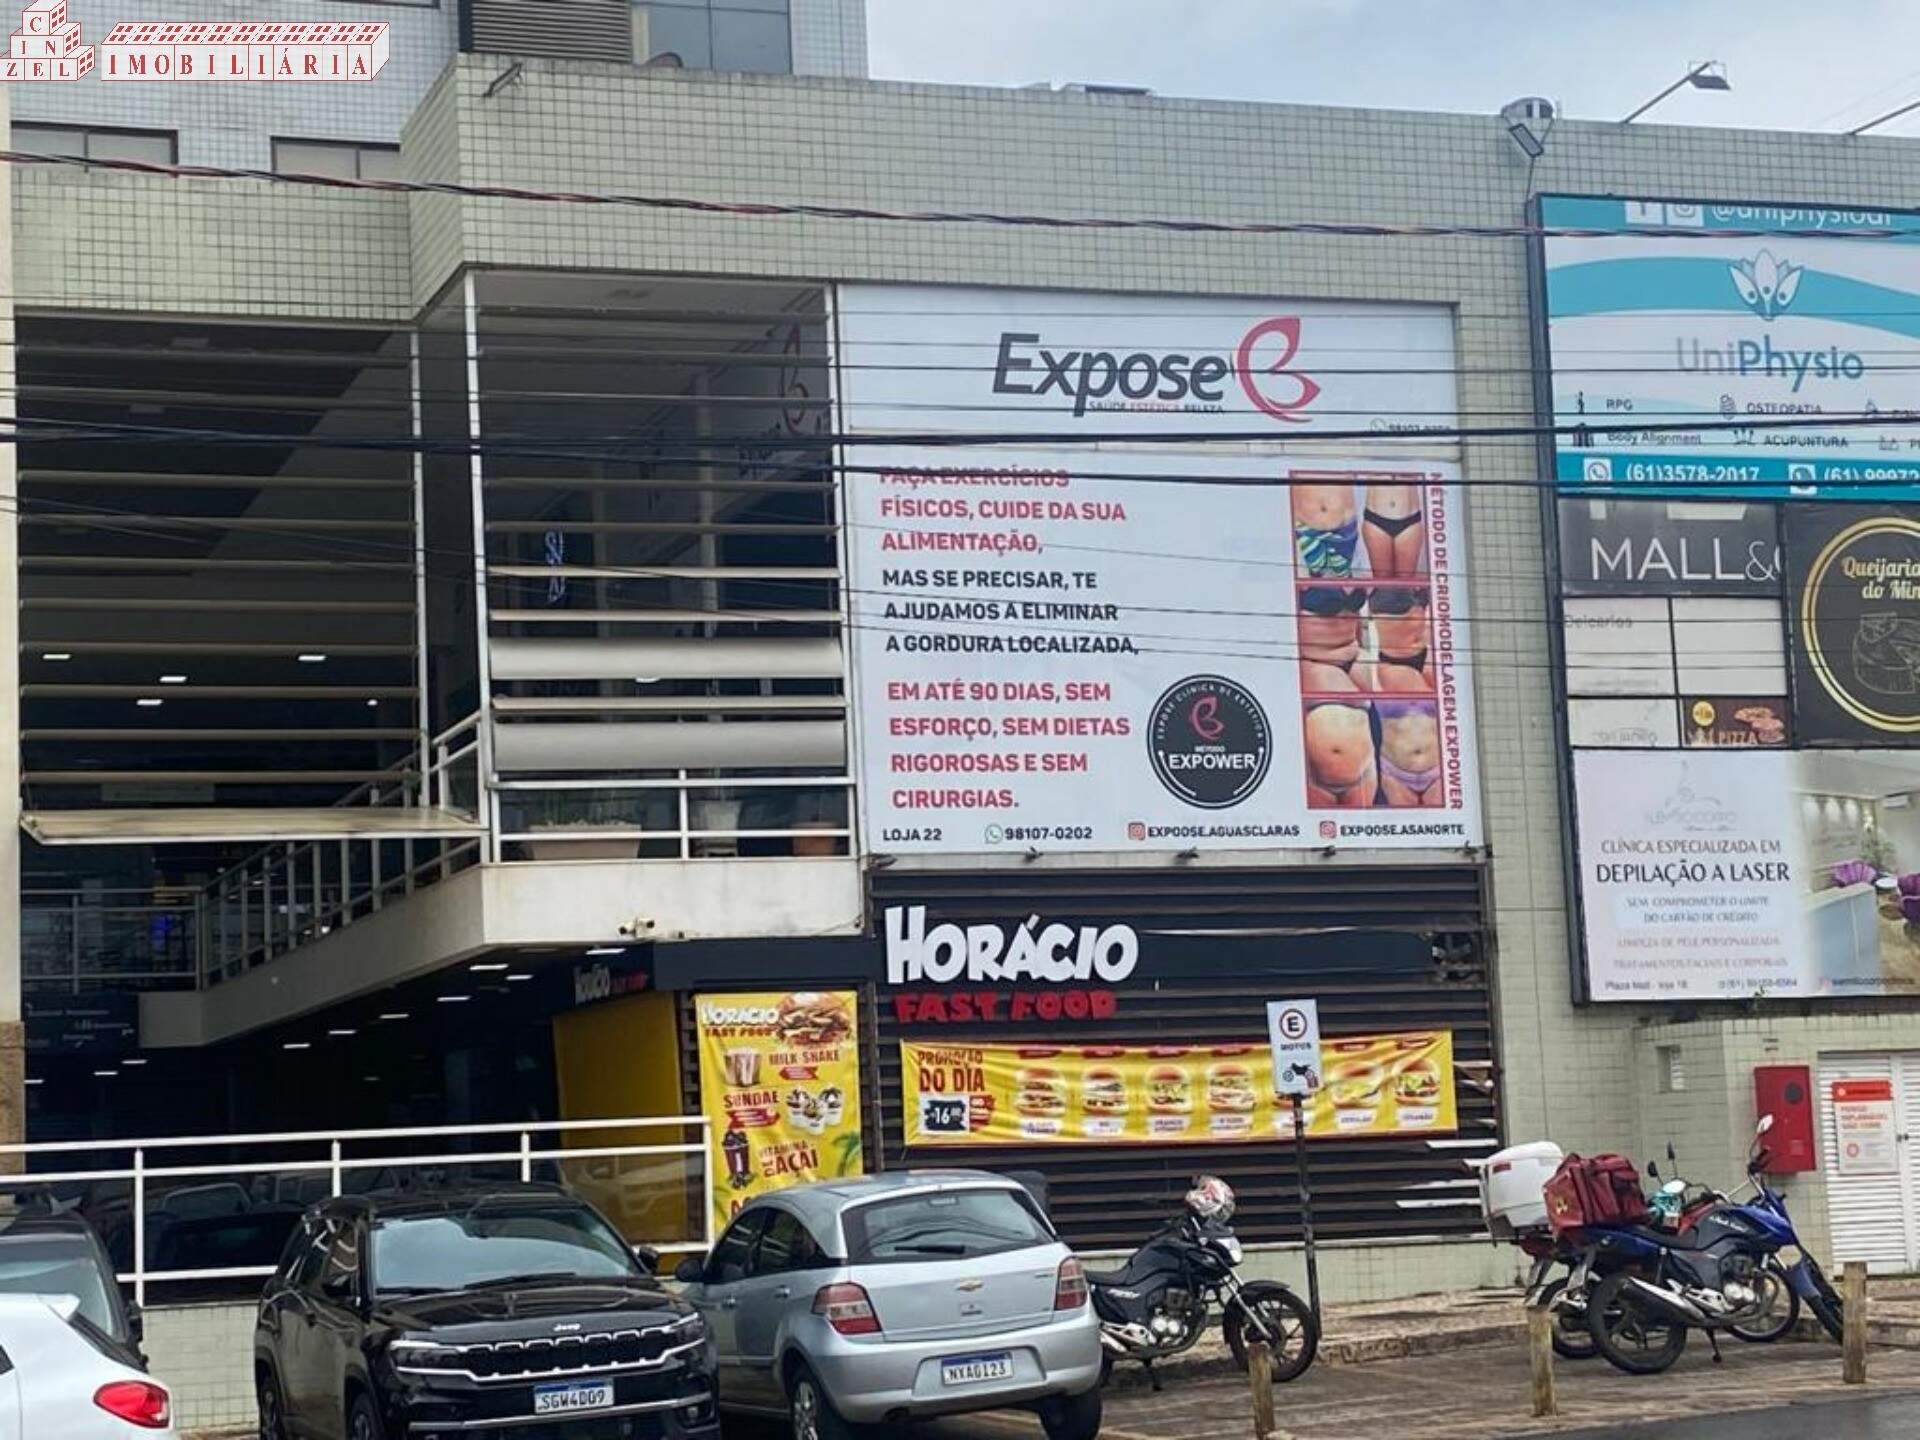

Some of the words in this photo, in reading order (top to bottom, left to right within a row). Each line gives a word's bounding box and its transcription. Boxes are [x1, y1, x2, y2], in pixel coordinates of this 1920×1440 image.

[1675, 335, 1864, 392] UniPhysio
[992, 332, 1229, 418] Expose
[1606, 398, 1633, 411] RPG
[1764, 434, 1850, 448] ACUPUNTURA
[881, 495, 974, 520] FÍSICOS,
[978, 502, 1044, 520] CUIDE
[1048, 502, 1077, 520] DA
[1081, 503, 1126, 521] SUA
[882, 530, 1044, 557] ALIMENTAÇÃO,
[1433, 549, 1449, 571] DE
[882, 570, 928, 587] MAS
[932, 570, 958, 587] SE
[963, 571, 1069, 590] PRECISAR,
[1072, 573, 1097, 589] TE
[1862, 580, 1885, 599] do
[884, 602, 1000, 620] AJUDAMOS
[1023, 602, 1118, 621] ELIMINAR
[886, 635, 900, 651] A
[903, 634, 1003, 653] GORDURA
[1008, 636, 1140, 656] LOCALIZADA,
[1436, 573, 1457, 723] CRIOMODELAGEM
[888, 682, 920, 700] EM
[925, 678, 965, 700] ATÉ
[970, 682, 998, 700] 90
[1003, 683, 1061, 704] DIAS,
[1065, 683, 1111, 701] SEM
[890, 717, 998, 741] ESFORÇO,
[1002, 717, 1048, 736] SEM
[1053, 717, 1130, 736] DIETAS
[891, 753, 1020, 773] RIGOROSAS
[1024, 754, 1037, 771] E
[1041, 754, 1088, 772] SEM
[1168, 753, 1257, 770] EXPOWER
[1445, 725, 1464, 810] EXPOWER
[892, 788, 1020, 808] CIRURGIAS.
[883, 828, 920, 841] LOJA
[923, 828, 943, 841] 22
[1004, 825, 1093, 840] 98107-0202
[1600, 836, 1654, 854] CLÍNICA
[1657, 839, 1758, 854] ESPECIALIZADA
[1760, 839, 1781, 853] EM
[1596, 858, 1708, 887] DEPILAÇÃO
[1711, 864, 1726, 882] A
[1729, 862, 1791, 882] LASER
[884, 905, 1139, 984] HORÁCIO
[894, 991, 998, 1023] FAST
[1009, 989, 1119, 1021] FOOD
[1287, 1016, 1300, 1032] E
[920, 1068, 946, 1092] DO
[952, 1067, 985, 1092] DIA
